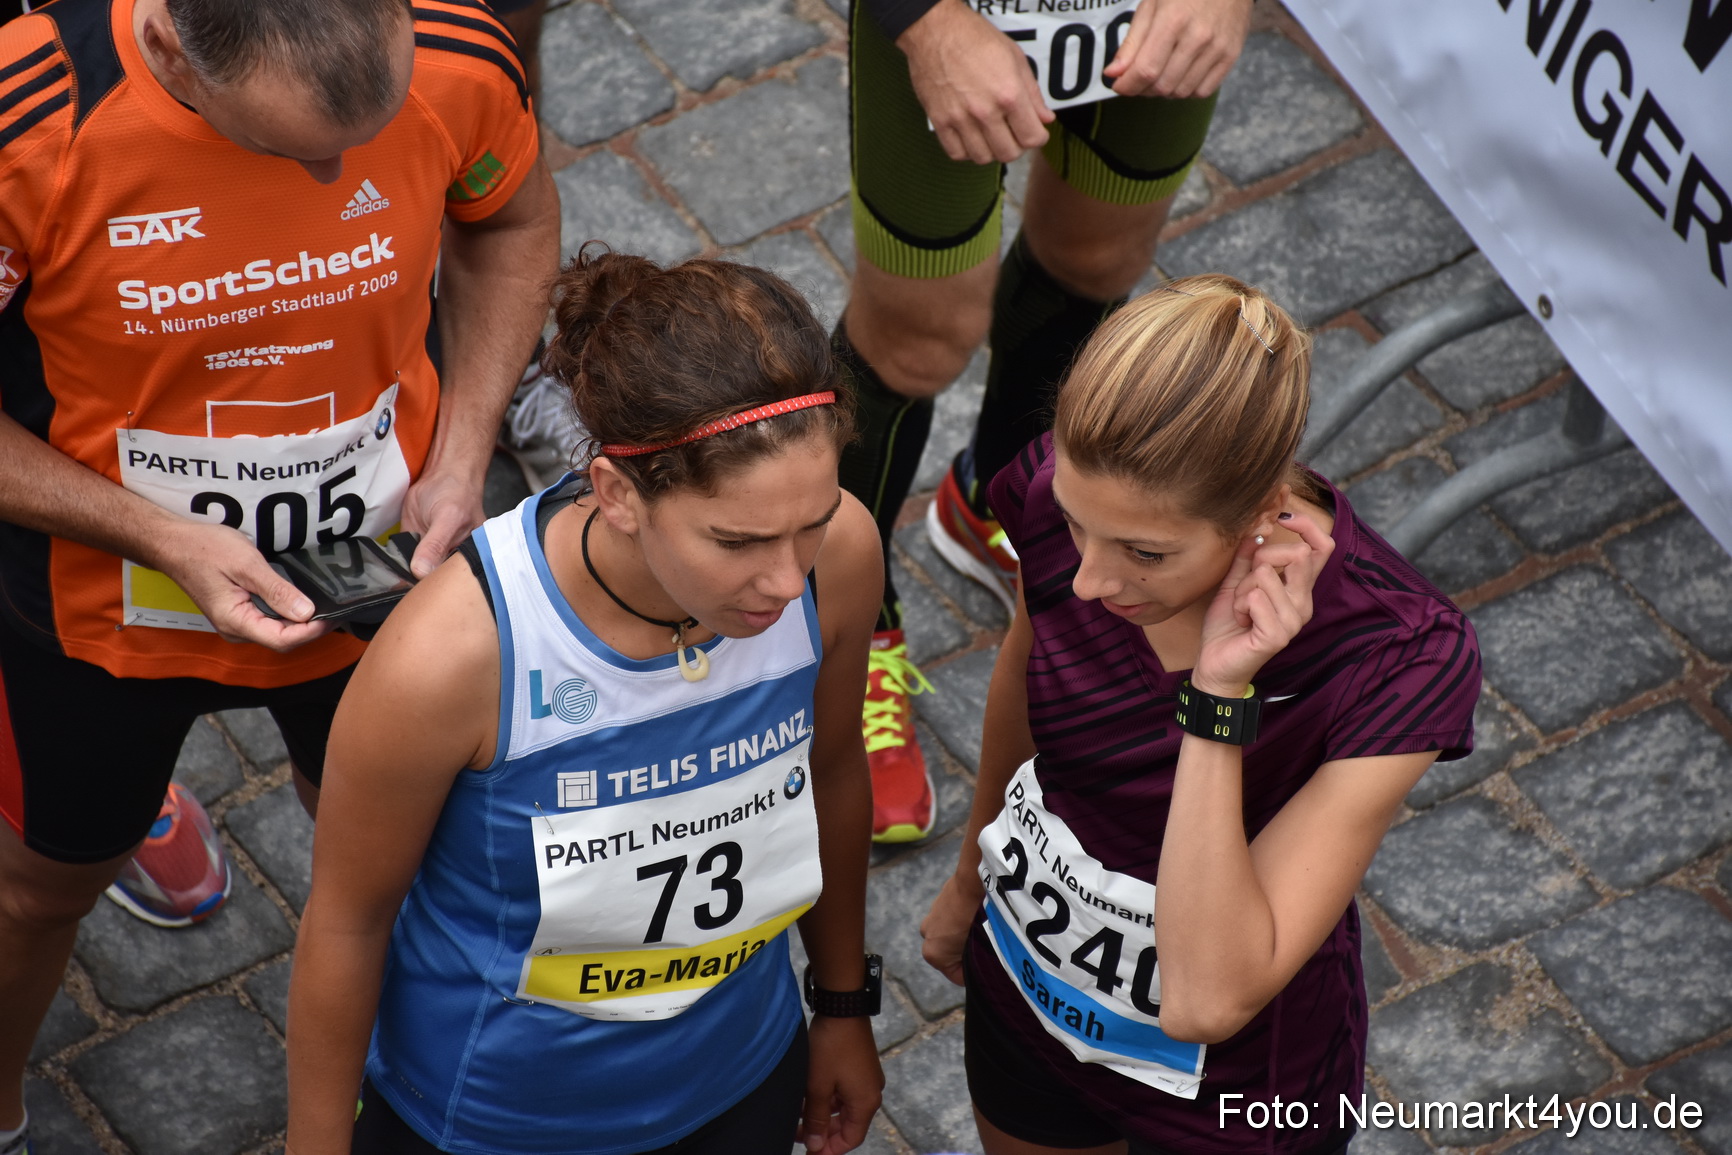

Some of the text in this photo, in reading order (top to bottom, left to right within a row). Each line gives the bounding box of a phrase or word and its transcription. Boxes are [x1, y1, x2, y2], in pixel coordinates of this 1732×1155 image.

[108, 213, 206, 247] DAK
[340, 197, 390, 221] adidas
[118, 232, 394, 315] SportScheck
[123, 270, 398, 335] 14. Nürnberger Stadtlauf 2009
[204, 339, 334, 362] TSV Katzwang
[206, 355, 285, 370] 1905 e.V.
[128, 435, 365, 481] PARTL Neumarkt
[529, 669, 598, 725] LG
[607, 708, 808, 798] TELIS FINANZ
[544, 788, 776, 869] PARTL Neumarkt
[1008, 781, 1155, 929] PARTL Neumark
[636, 841, 744, 945] 73
[1021, 959, 1105, 1042] Sarah
